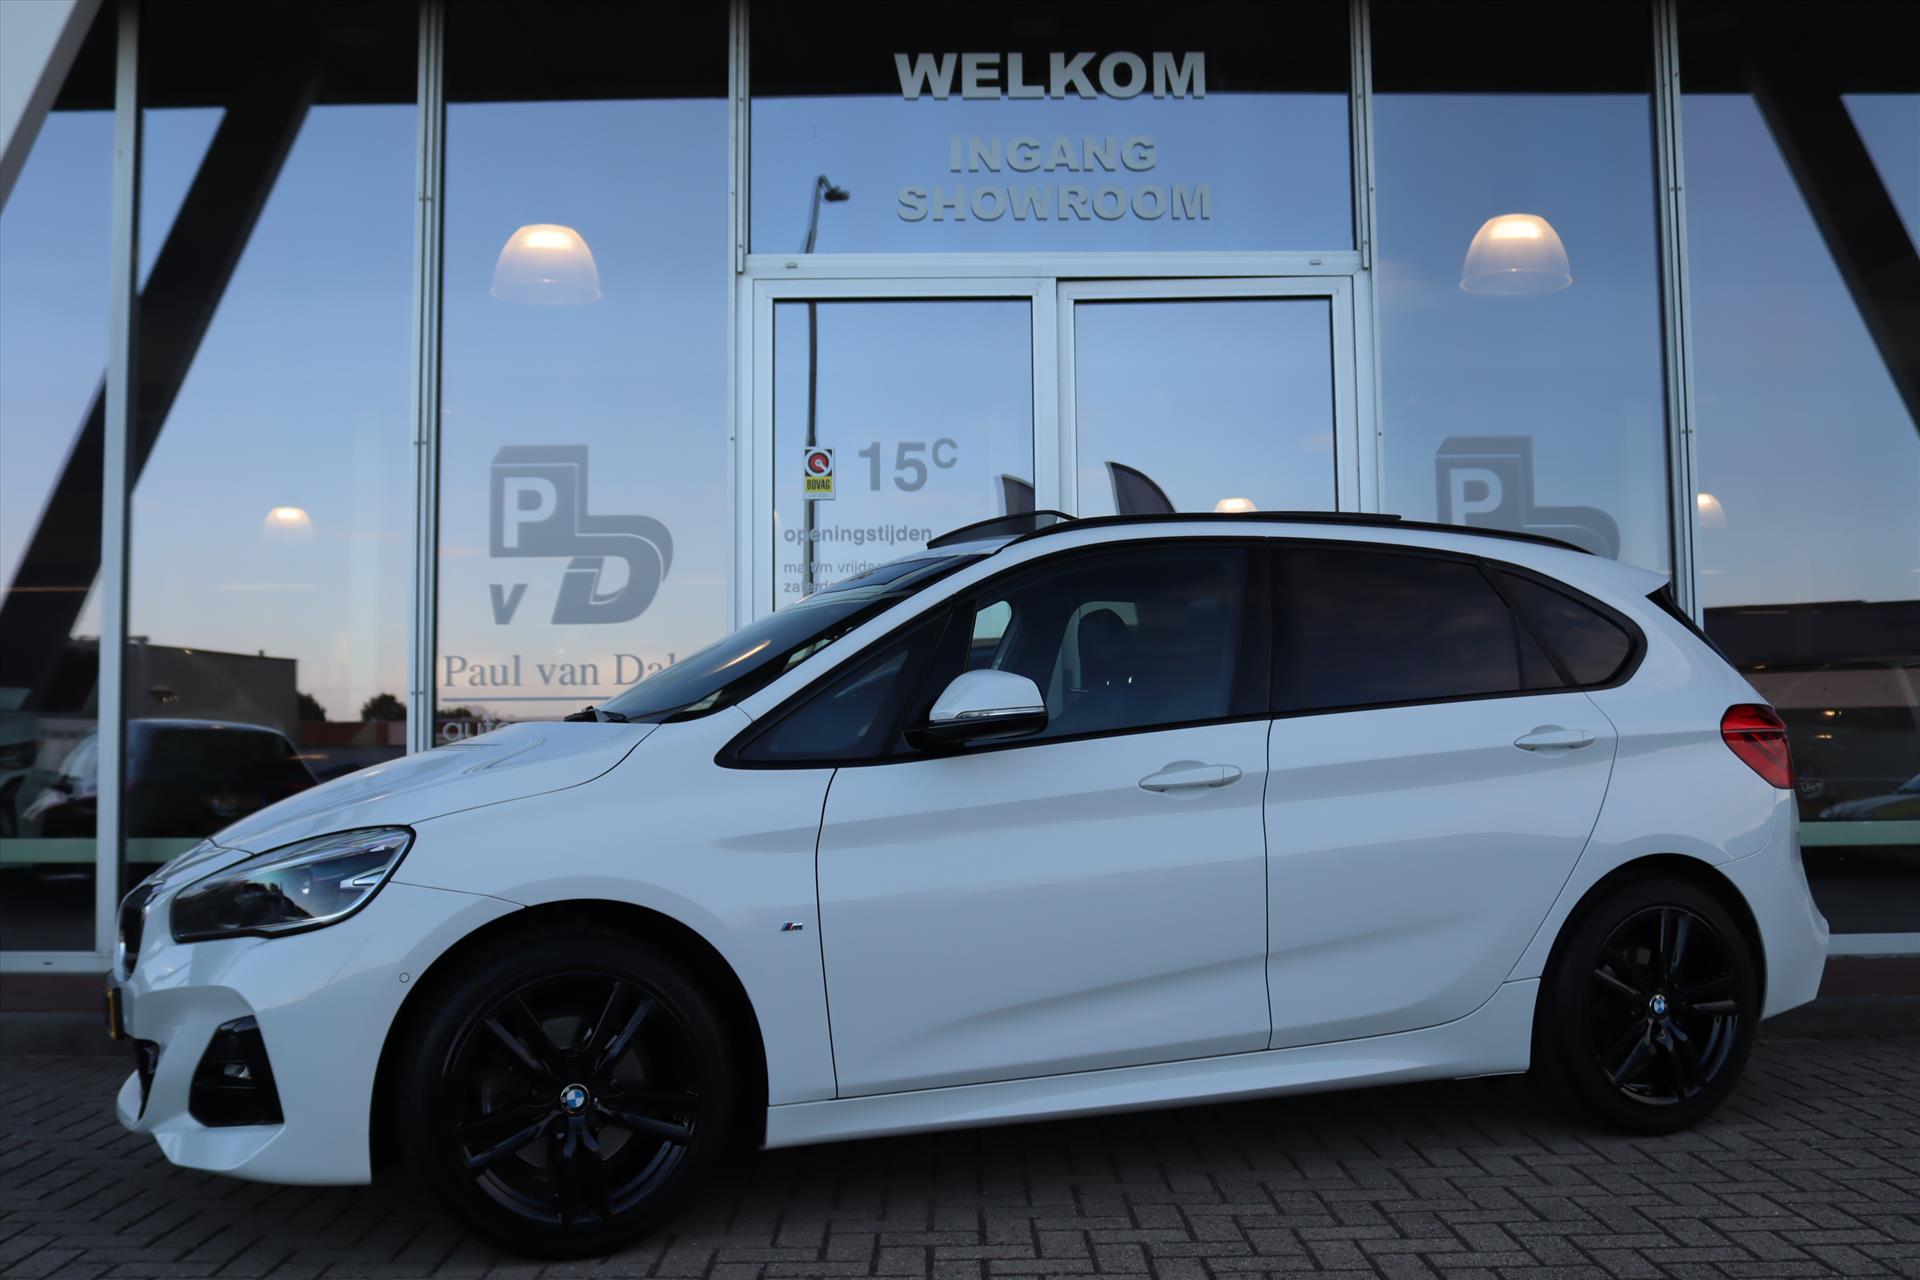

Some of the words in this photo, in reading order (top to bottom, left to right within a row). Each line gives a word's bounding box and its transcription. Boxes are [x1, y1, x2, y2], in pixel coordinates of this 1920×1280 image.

[894, 51, 1206, 100] WELKOM
[950, 136, 1156, 173] INGANG
[897, 184, 1212, 222] SHOWROOM
[806, 479, 831, 490] BOVAG
[784, 525, 932, 545] openingstijden
[837, 560, 879, 573] vrijda
[443, 655, 521, 687] Paul
[537, 664, 599, 686] van
